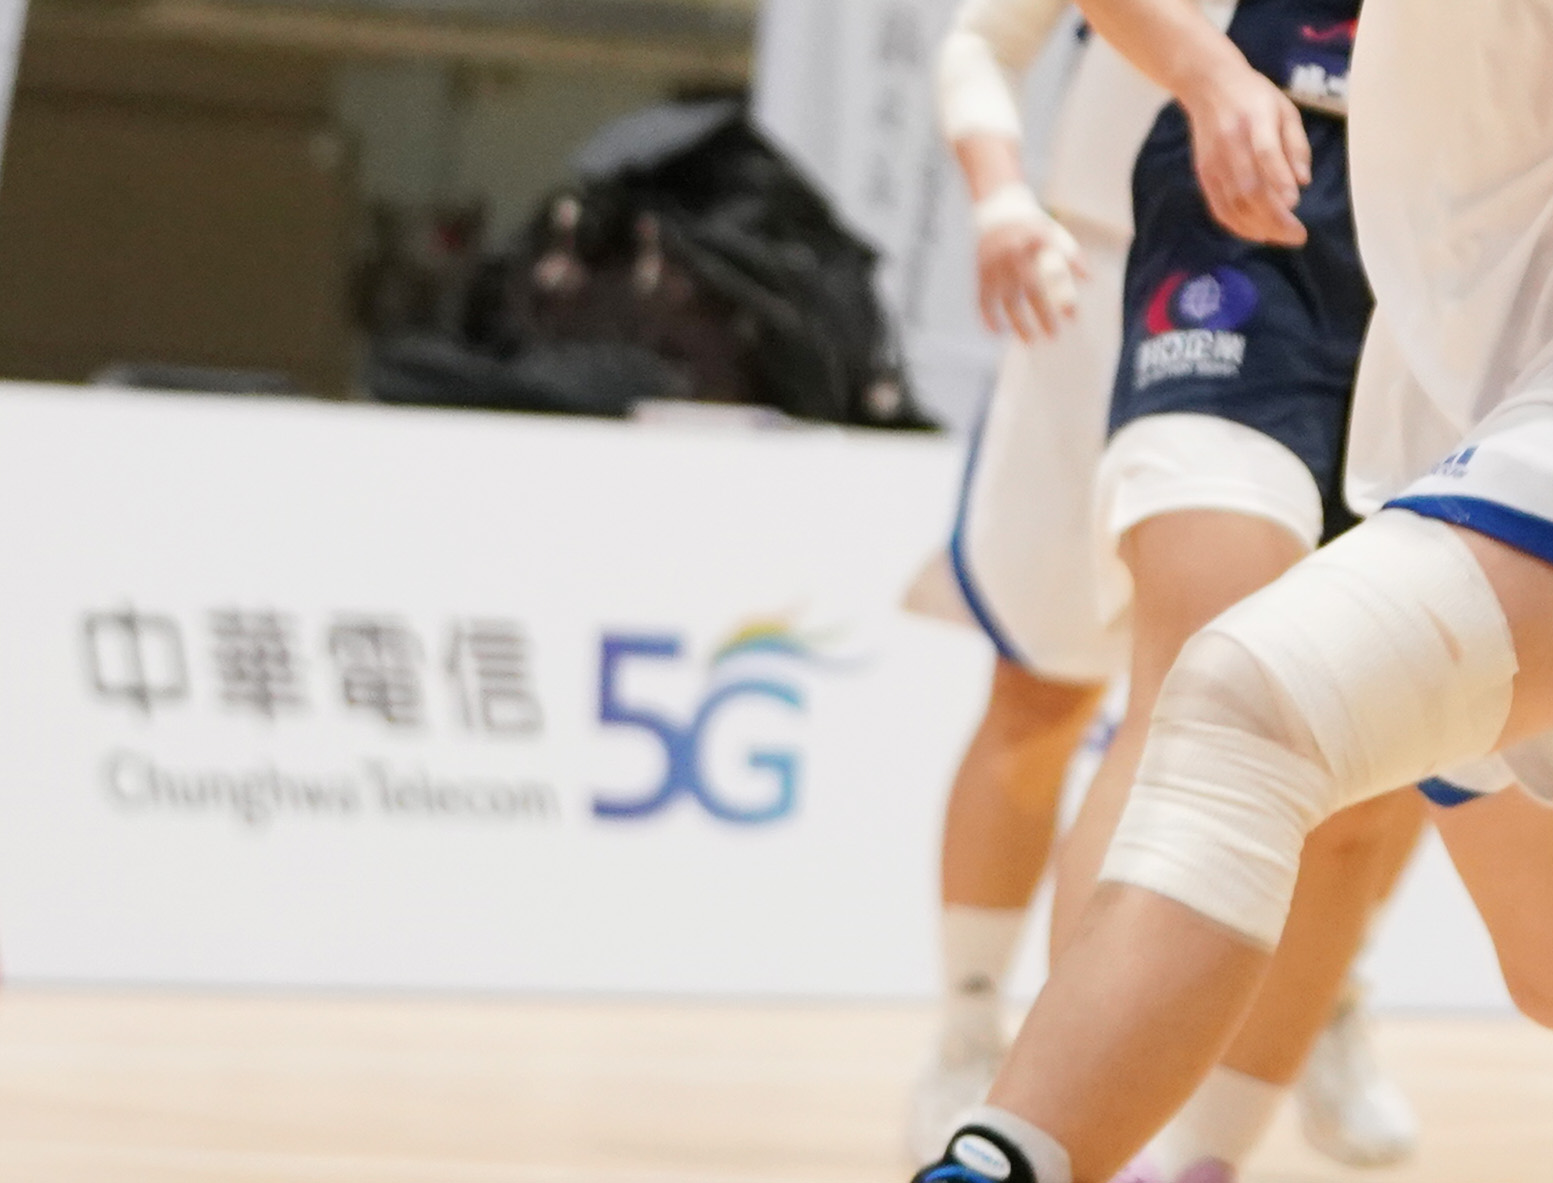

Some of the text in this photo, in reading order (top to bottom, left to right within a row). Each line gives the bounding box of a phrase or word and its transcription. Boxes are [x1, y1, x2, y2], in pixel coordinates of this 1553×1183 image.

[80, 598, 547, 739] 中華電信
[590, 628, 807, 826] 5G
[102, 746, 560, 828] Chunghwa Telecom
